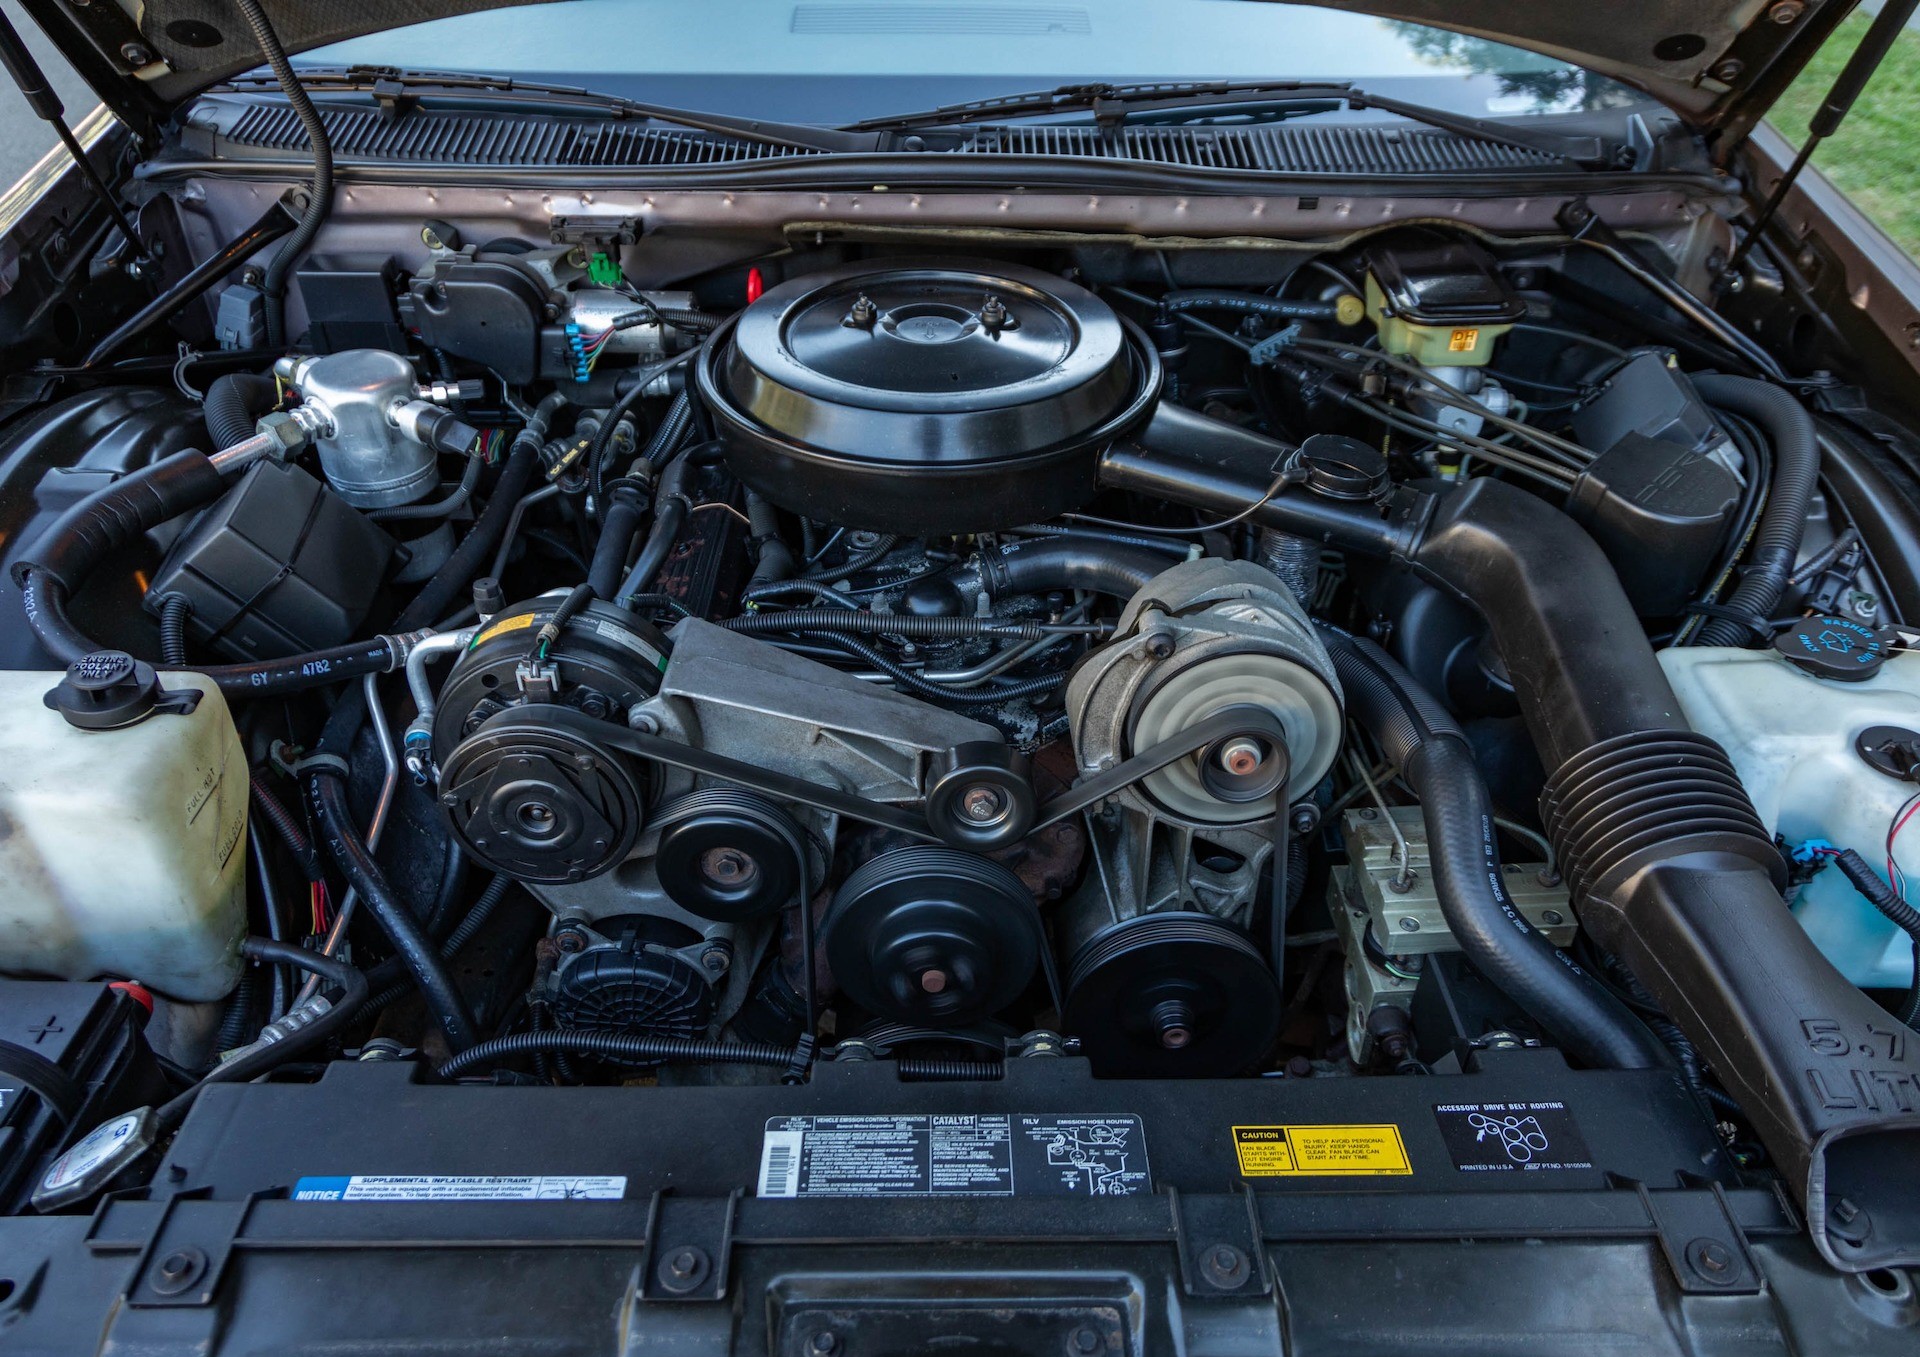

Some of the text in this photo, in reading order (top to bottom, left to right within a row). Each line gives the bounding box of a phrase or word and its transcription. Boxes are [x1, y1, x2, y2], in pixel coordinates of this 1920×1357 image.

[1454, 330, 1475, 341] DH
[1821, 618, 1874, 639] WASHER
[1798, 634, 1821, 653] ONLY
[81, 656, 126, 665] ENGINE
[73, 662, 128, 672] COOLANT
[251, 659, 331, 686] GY 4782
[80, 669, 110, 679] ONLY
[187, 767, 216, 813] FULL HOT
[1800, 1018, 1905, 1062] 5.7
[1806, 1068, 1920, 1113] LIT
[1437, 1104, 1479, 1112] ACCESSORY
[1483, 1103, 1506, 1111] DRIVE
[1530, 1102, 1564, 1110] ROUTING
[932, 1115, 975, 1126] CATALYST
[1241, 1131, 1279, 1140] CAUTION
[295, 1190, 340, 1200] NOTICE
